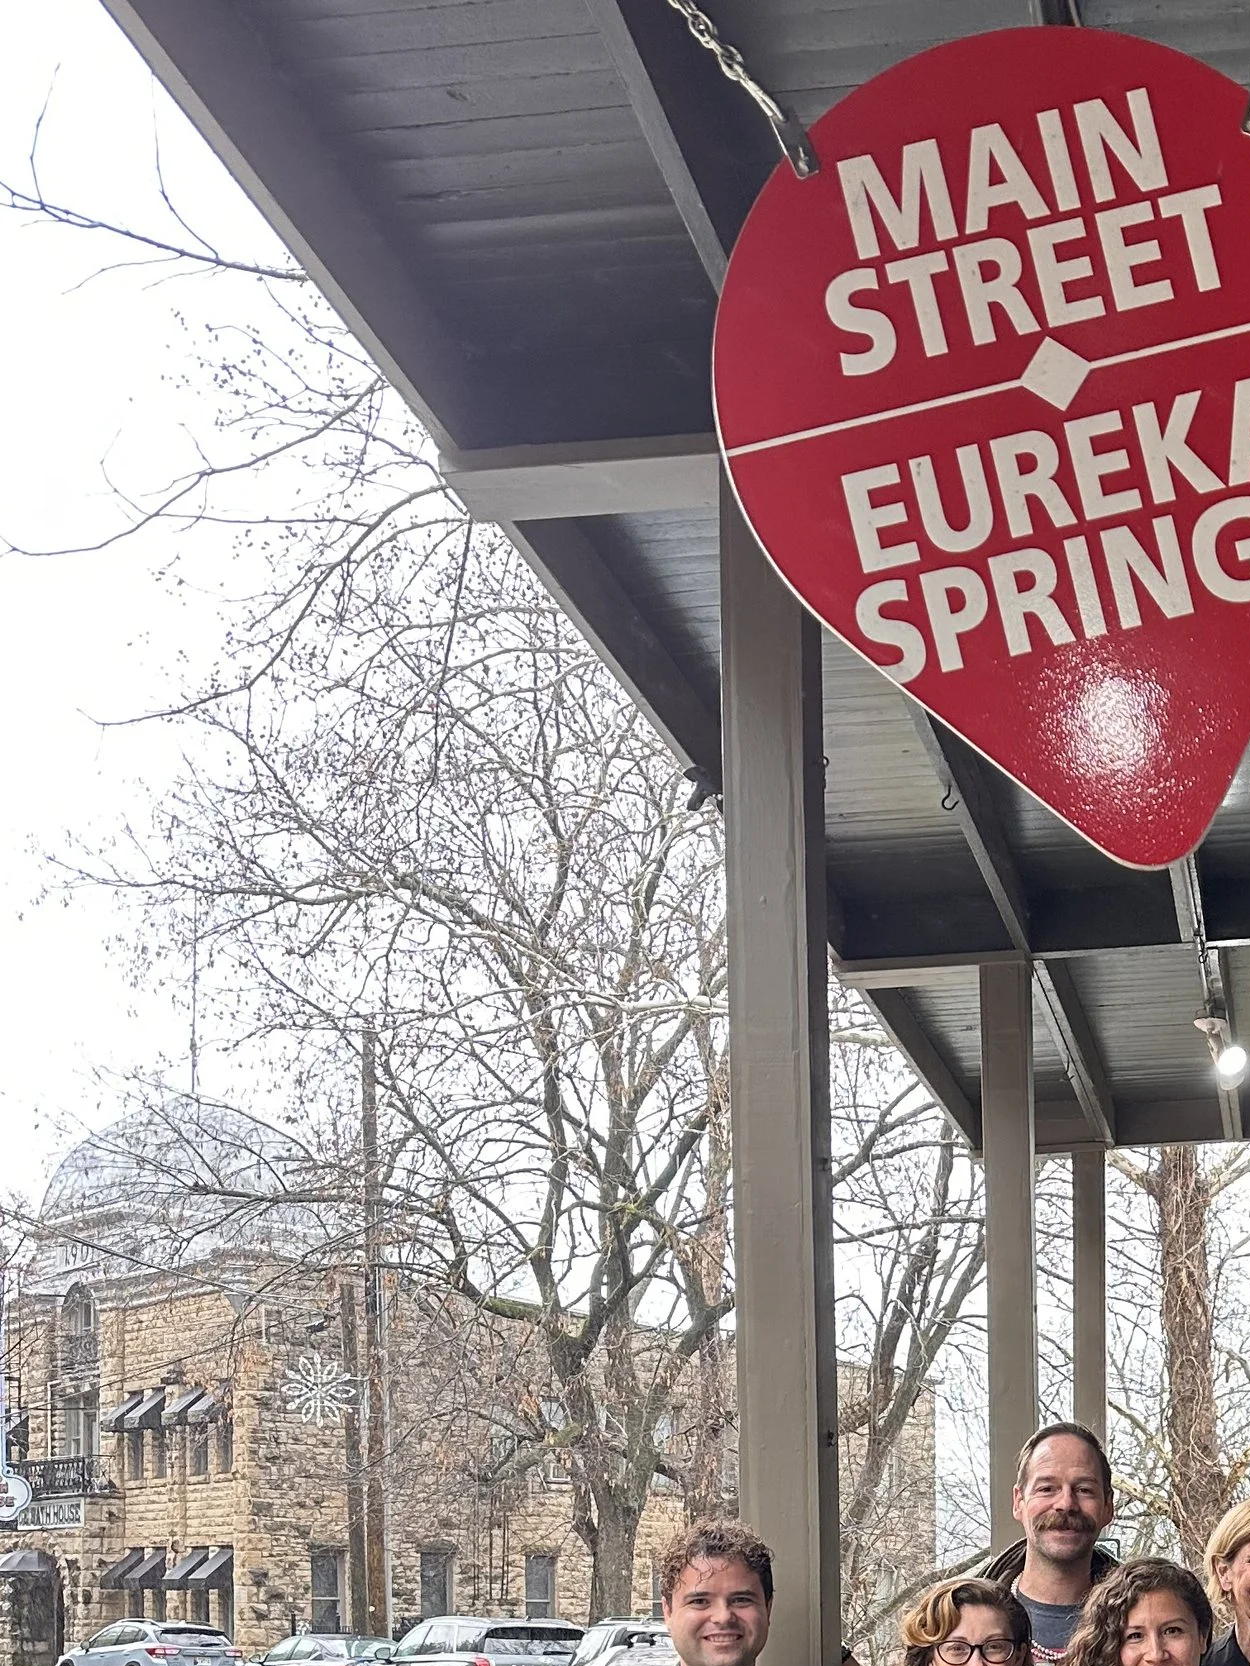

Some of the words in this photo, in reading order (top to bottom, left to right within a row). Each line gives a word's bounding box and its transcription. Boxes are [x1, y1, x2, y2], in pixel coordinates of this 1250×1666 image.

[836, 88, 1169, 260] MAIN
[824, 184, 1222, 377] STREET
[53, 1503, 82, 1524] HOUSE
